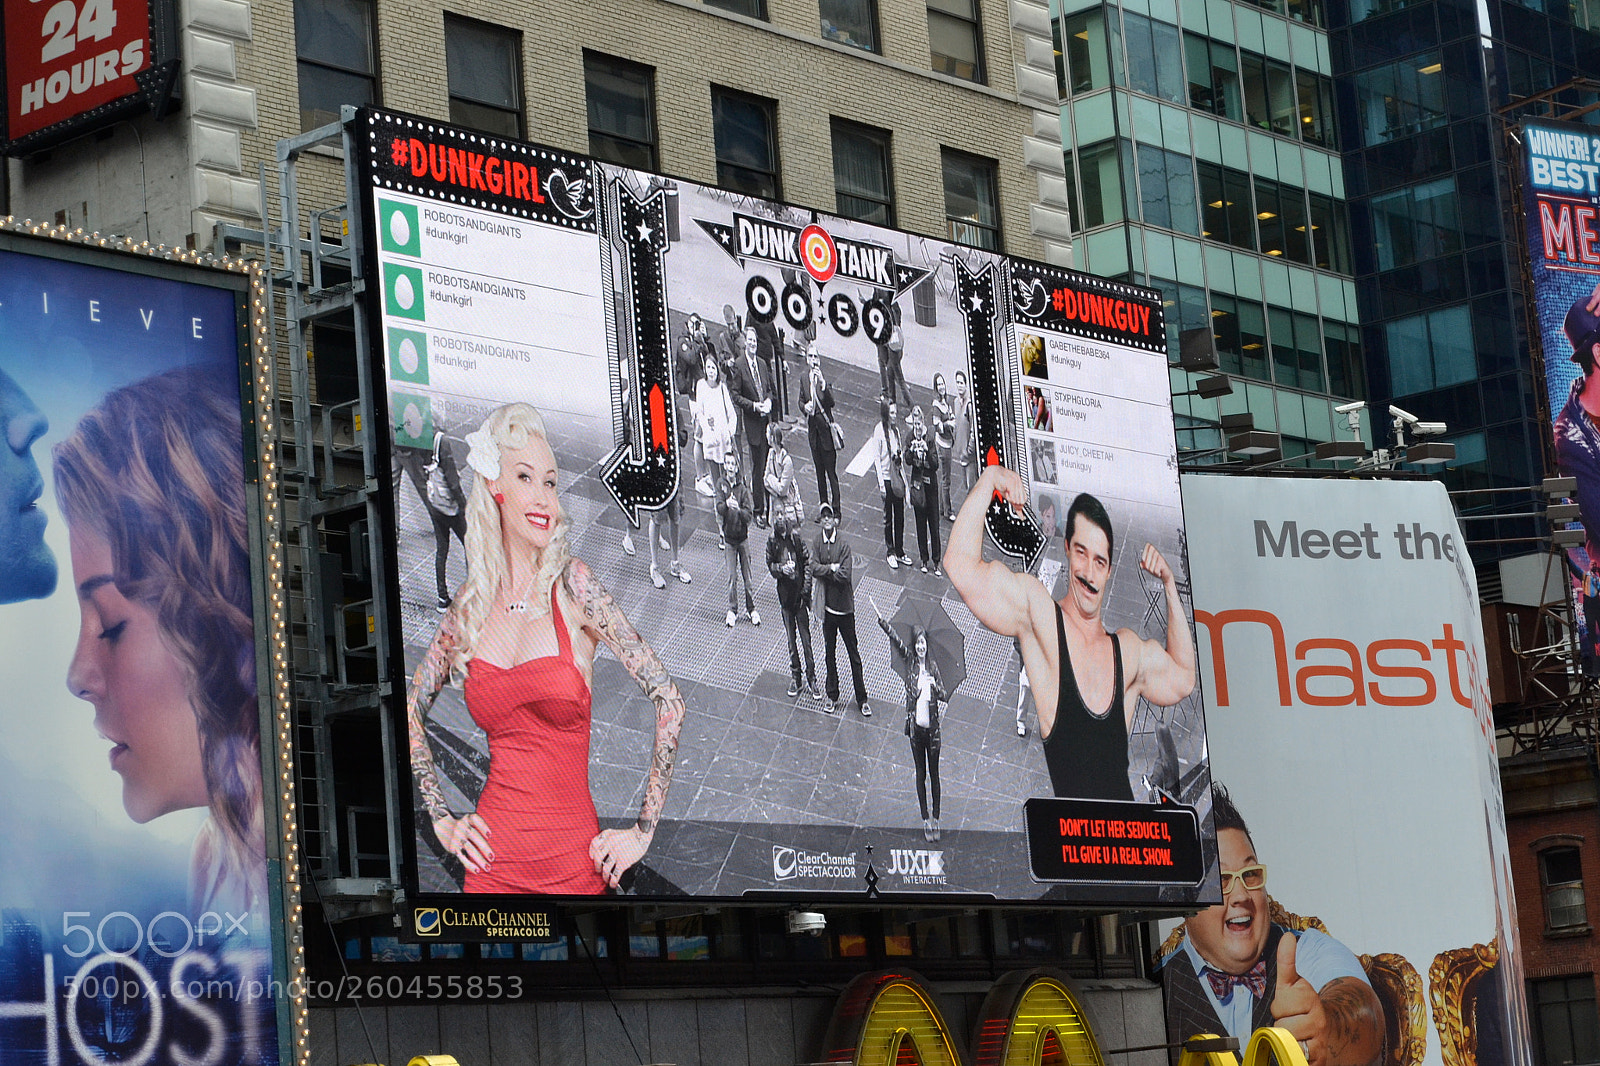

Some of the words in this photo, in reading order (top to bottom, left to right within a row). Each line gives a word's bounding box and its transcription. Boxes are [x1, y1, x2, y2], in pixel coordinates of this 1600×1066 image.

[41, 0, 117, 64] 24
[20, 38, 144, 116] HOURS
[1527, 128, 1591, 162] WINNER!
[390, 137, 545, 204] #DUNKGIRL
[1531, 156, 1599, 192] BEST
[424, 208, 522, 239] ROBOTSANDGIANTS
[426, 226, 468, 245] #dunkgirl
[1538, 200, 1600, 266] ME
[738, 217, 798, 264] DUNK
[836, 242, 892, 286] TANK
[428, 271, 527, 301] ROBOTSANDGIANTS
[430, 289, 473, 308] #dunkgirl
[0, 292, 203, 339] IEVE
[1052, 287, 1150, 336] #DUNKGUY
[432, 335, 531, 363] ROBOTSANDGIANTS
[434, 353, 477, 371] #dunkgirl
[1051, 354, 1082, 370] #dunkguy
[1055, 405, 1087, 421] #dunkguy
[1061, 459, 1092, 474] #dunkguy
[1253, 519, 1382, 560] Meet
[1394, 522, 1455, 563] the
[1059, 818, 1089, 837] DON'T
[1090, 819, 1106, 838] LET
[1107, 820, 1126, 839] HER
[1126, 821, 1161, 840] SEDUCE
[1161, 822, 1172, 843] U,
[1062, 844, 1080, 863] I'LL
[1080, 845, 1102, 864] GIVE
[1102, 846, 1110, 864] U
[1112, 846, 1119, 865] A
[1119, 847, 1142, 866] REAL
[1143, 847, 1174, 866] SHOW.
[798, 866, 857, 879] SPECTACOLOR
[903, 875, 947, 885] INTERACTIVE
[486, 927, 551, 937] SPECTACOLOR
